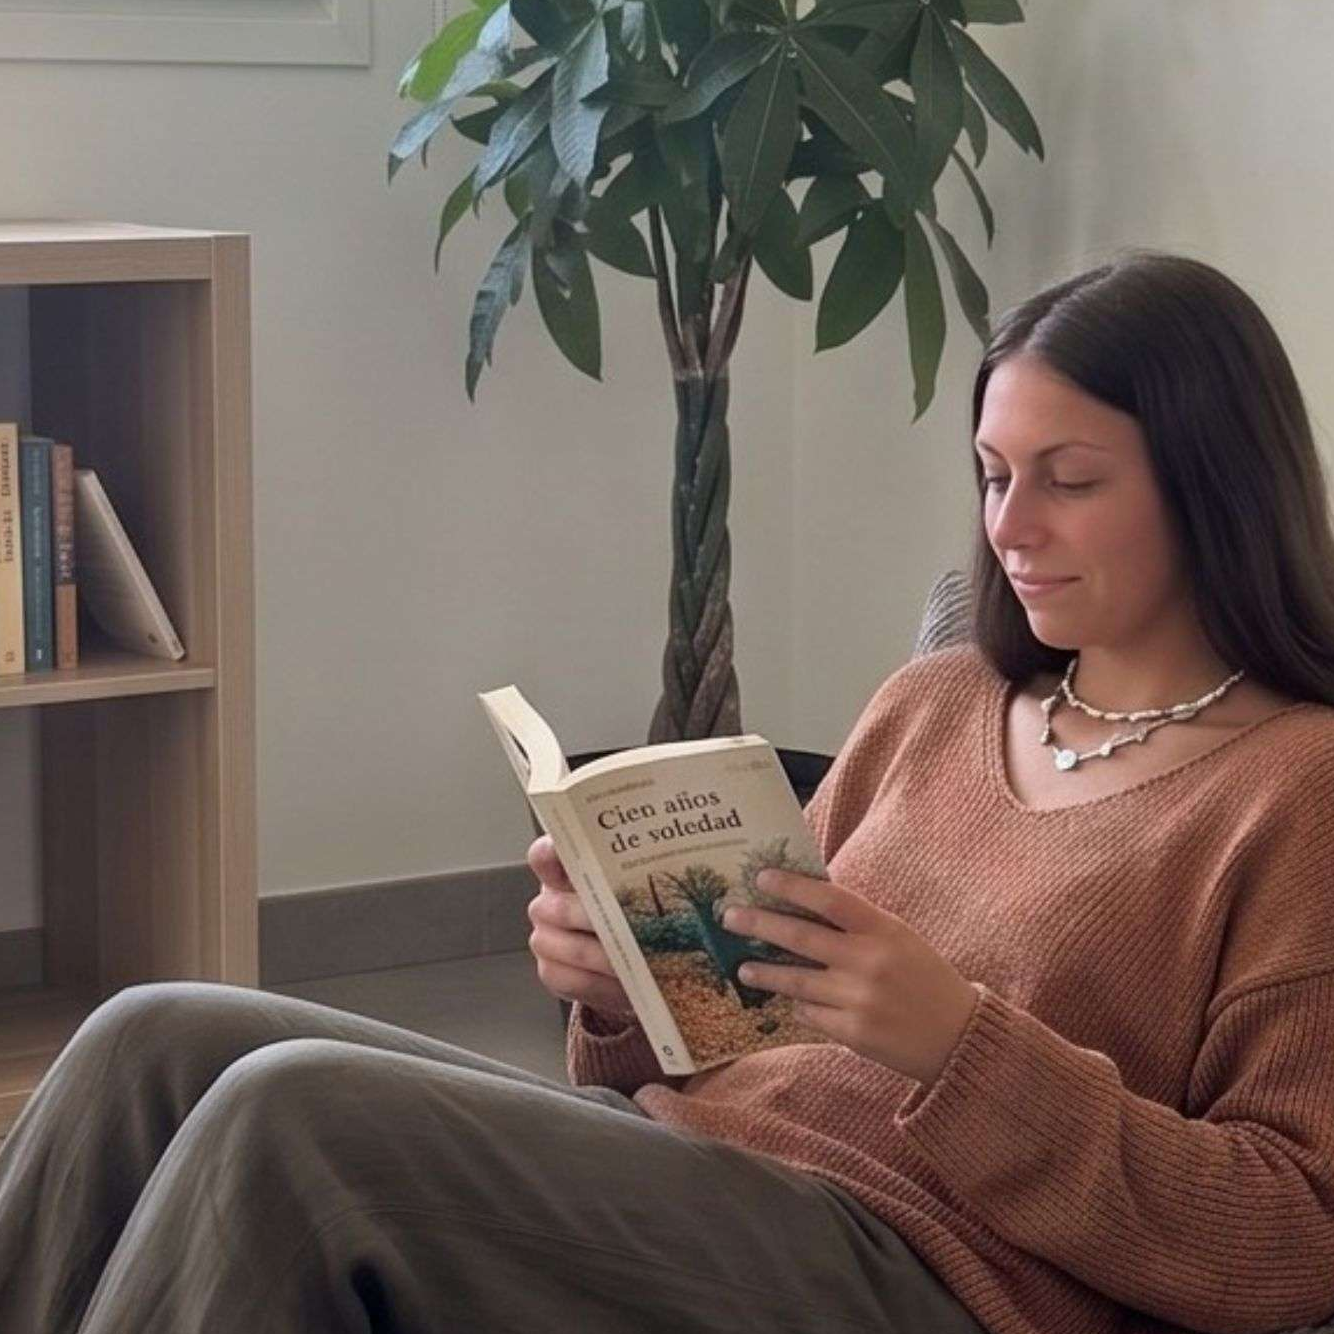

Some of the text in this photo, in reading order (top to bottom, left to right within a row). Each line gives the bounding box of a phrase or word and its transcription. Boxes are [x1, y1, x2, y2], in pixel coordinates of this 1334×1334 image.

[597, 802, 657, 830] Cien
[664, 790, 721, 814] años
[611, 832, 641, 854] de
